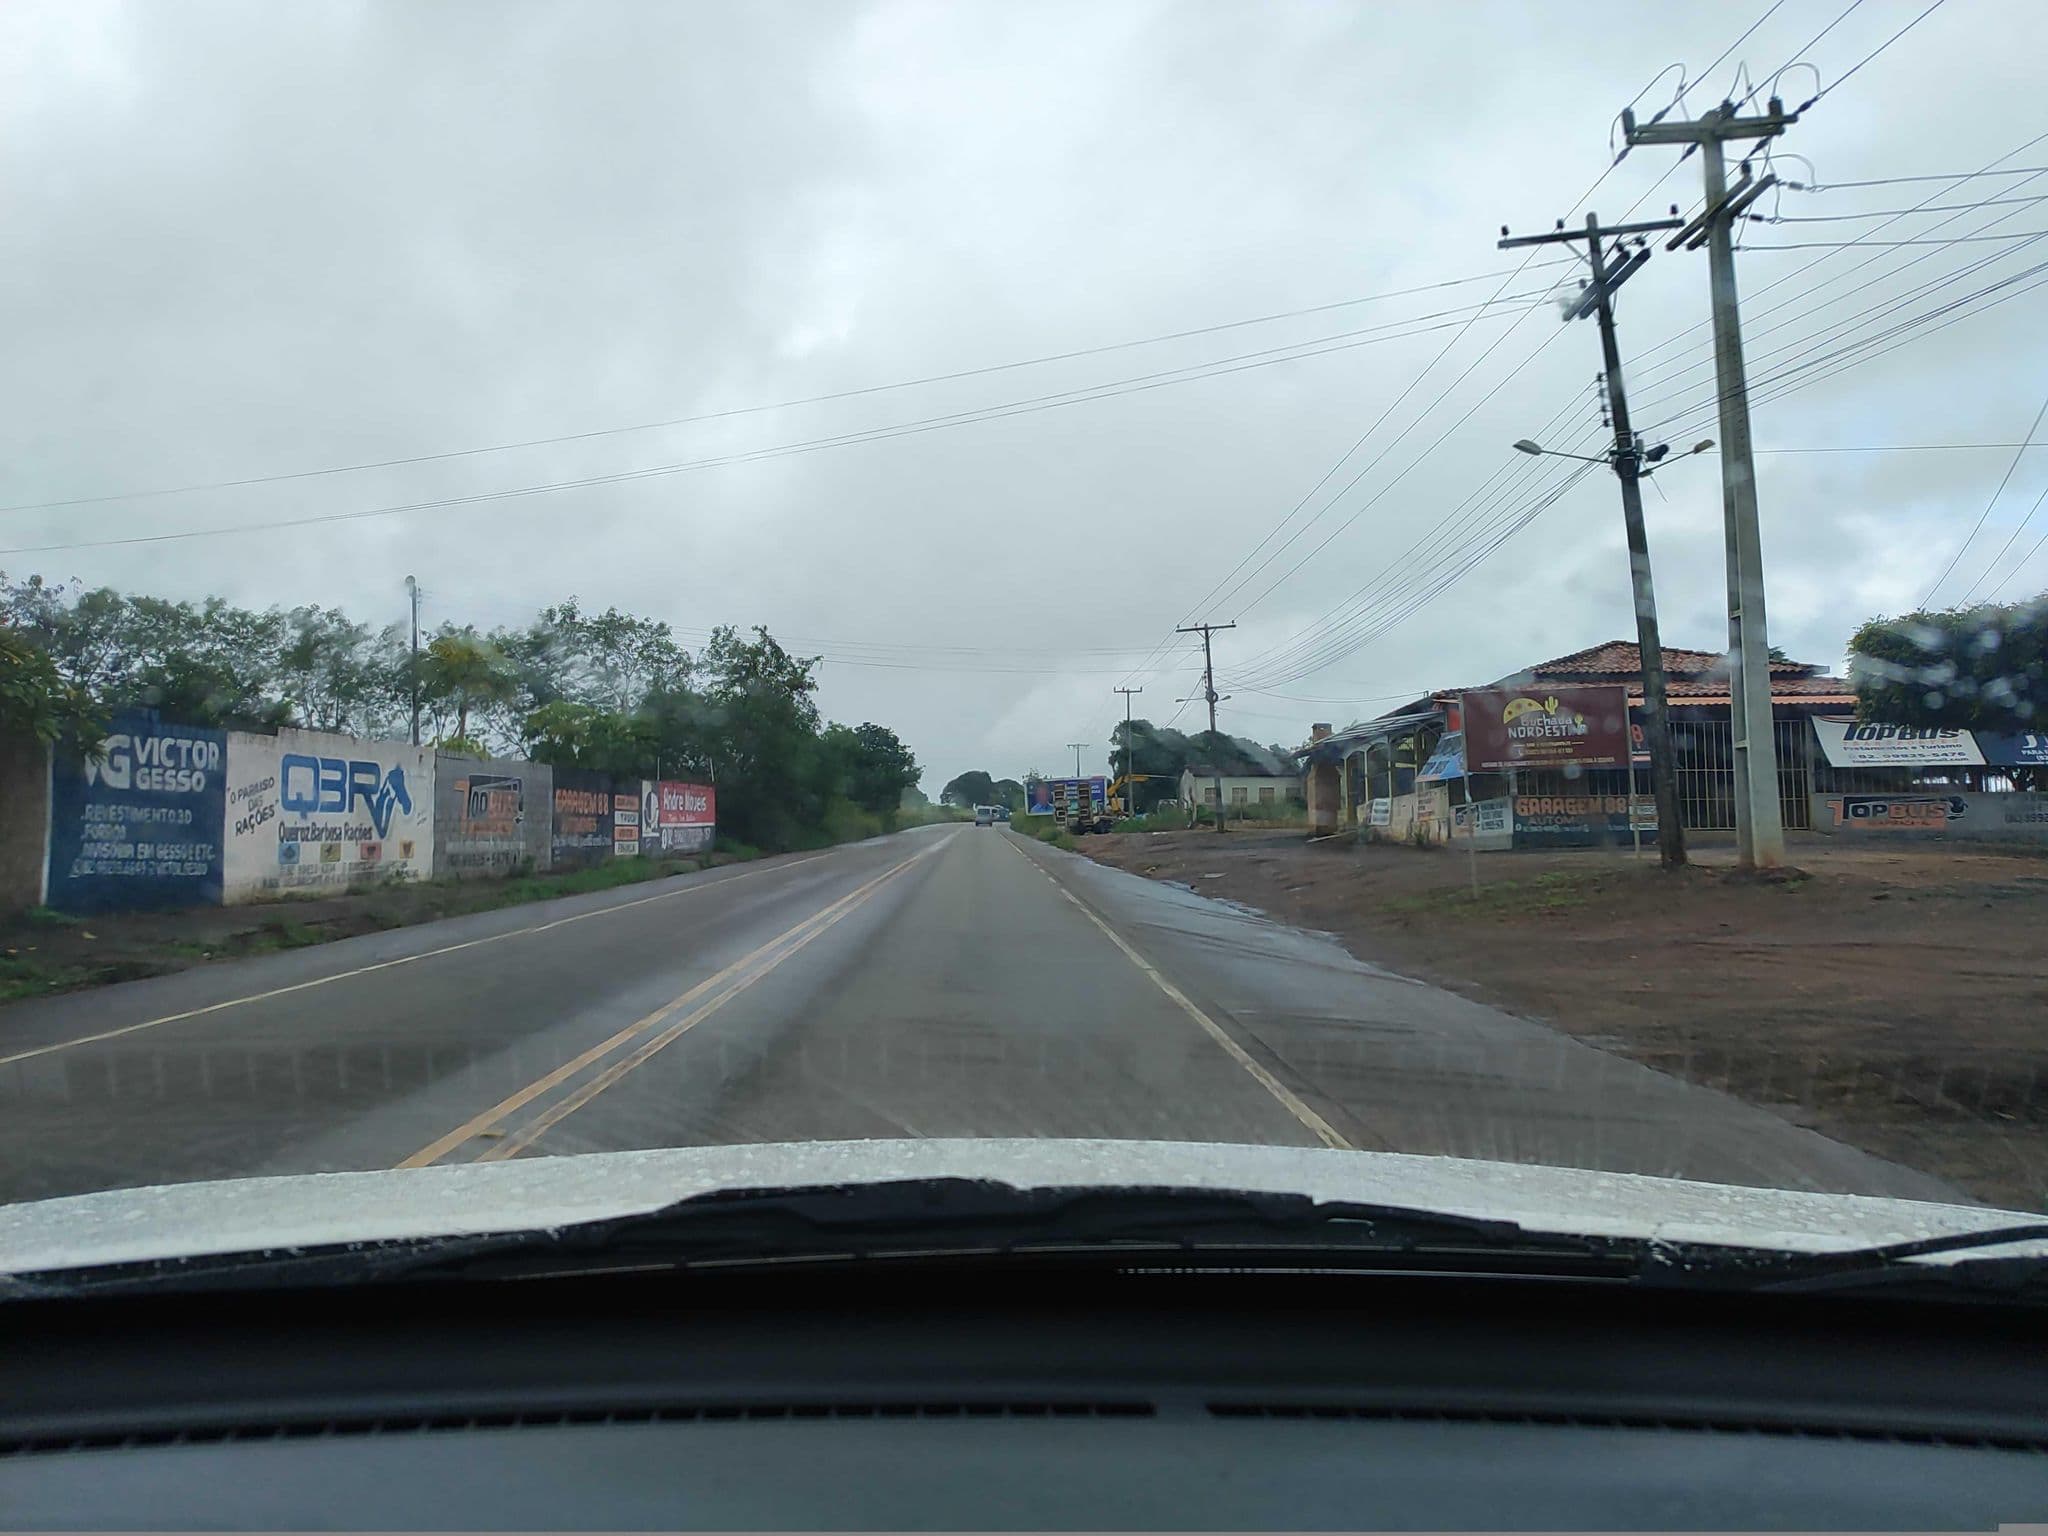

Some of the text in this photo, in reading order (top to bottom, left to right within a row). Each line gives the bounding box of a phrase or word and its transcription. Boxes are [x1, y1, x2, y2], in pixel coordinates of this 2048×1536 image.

[134, 735, 220, 771] VICTOR
[136, 767, 206, 793] GESSO
[1516, 797, 1602, 816] GARAGEM
[278, 820, 311, 842] Queiroz
